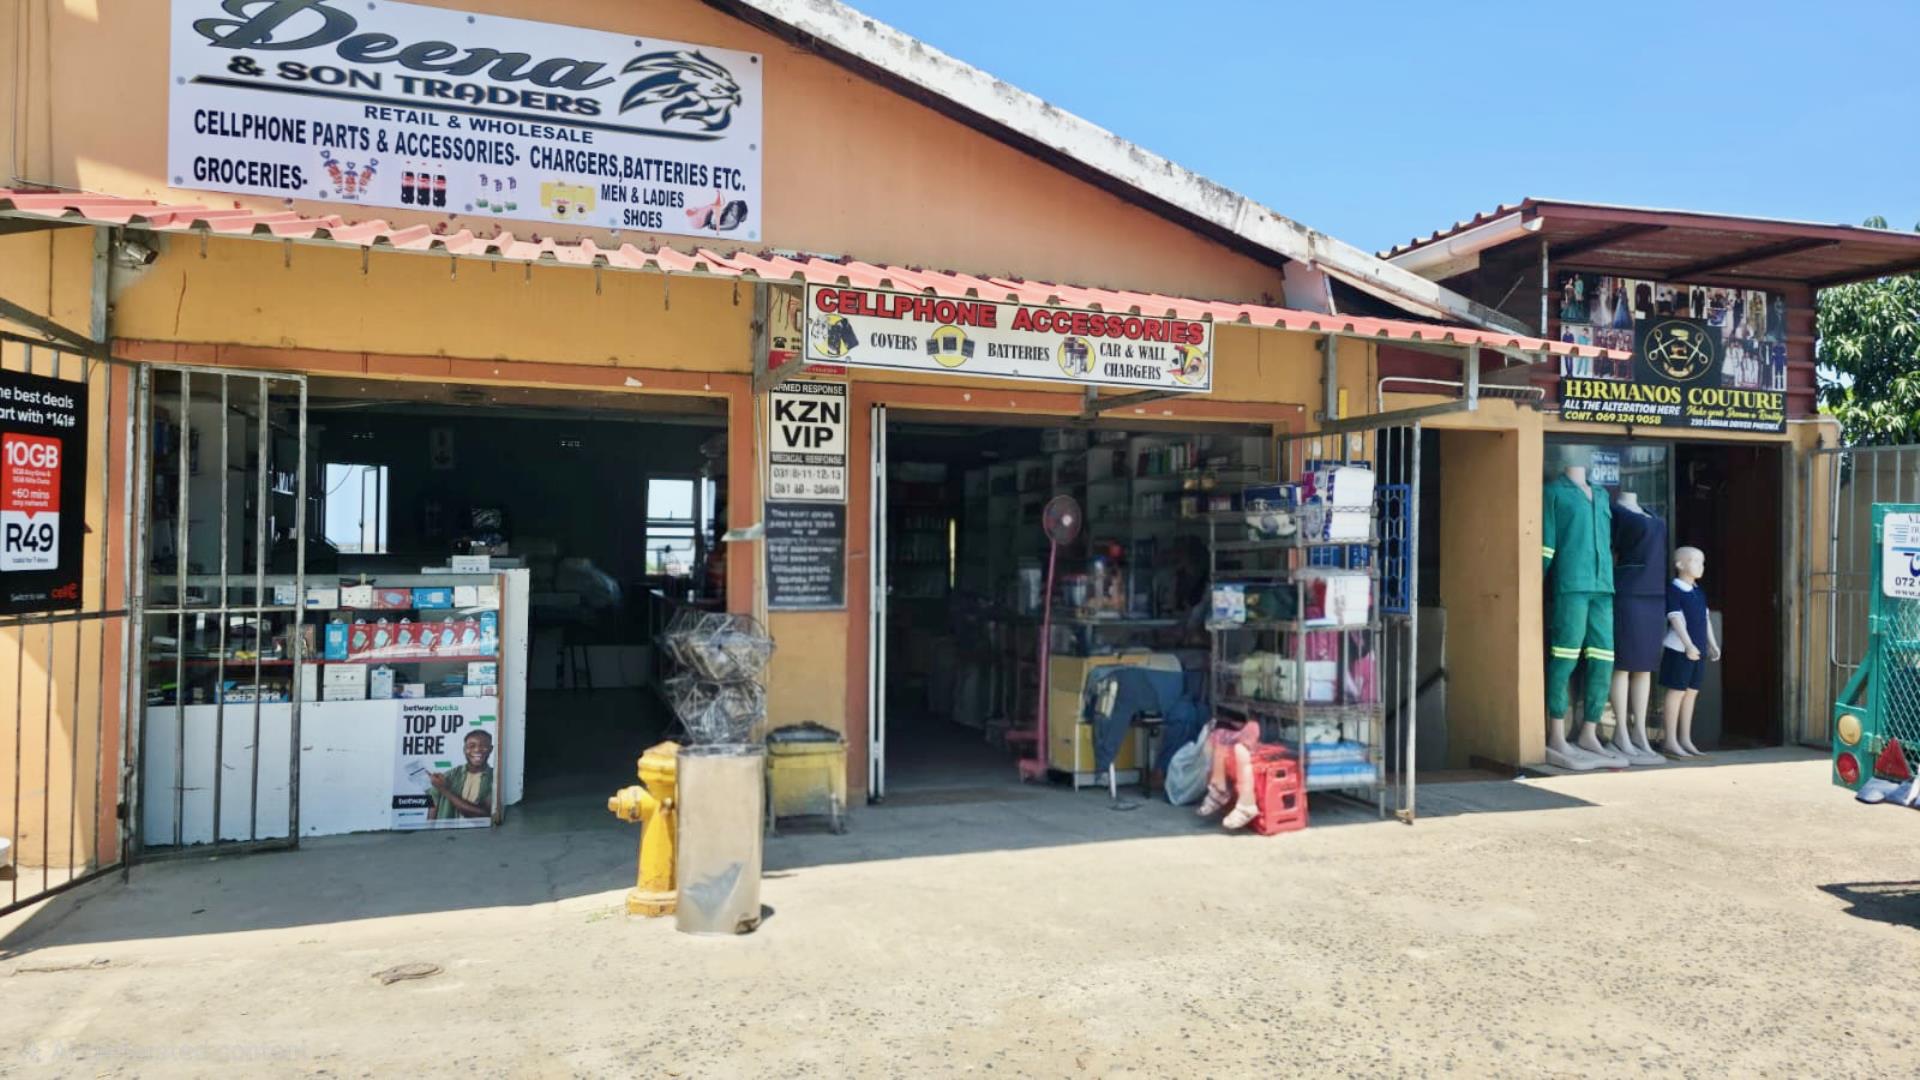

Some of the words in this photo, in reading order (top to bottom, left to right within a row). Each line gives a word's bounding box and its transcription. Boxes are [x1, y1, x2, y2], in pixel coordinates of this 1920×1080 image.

[193, 0, 616, 91] Deena
[227, 56, 264, 77] &
[277, 61, 382, 91] SON
[394, 75, 602, 116] TRADERS
[364, 105, 439, 127] RETAIL
[447, 115, 461, 128] &
[469, 117, 593, 145] WHOLESALE
[194, 109, 307, 145] CELLPHONE
[313, 121, 370, 151] PARTS
[376, 129, 389, 153] &
[713, 166, 746, 192] ETC.
[601, 183, 626, 203] MEN
[631, 187, 639, 202] &
[643, 188, 684, 209] LADIES
[623, 209, 662, 228] SHOES
[815, 287, 997, 329] CELLPHONE
[1011, 307, 1204, 345] ACCESSORIES
[870, 332, 918, 351] COVERS
[987, 342, 1050, 362] BATTERIES
[1100, 342, 1121, 358] CAR
[1125, 345, 1134, 359] &
[1139, 345, 1167, 361] WALL
[1103, 362, 1161, 380] CHARGERS
[13, 386, 41, 404] best
[42, 392, 74, 409] deals
[802, 384, 844, 395] RESPONSE
[1564, 380, 1682, 404] H3RMANOS
[1687, 387, 1784, 410] COUTURE
[17, 408, 44, 425] with
[775, 399, 841, 425] KZN
[1563, 399, 1581, 410] ALL
[1582, 401, 1601, 411] THE
[1601, 402, 1657, 415] ALTERATION
[1657, 404, 1682, 416] HERE
[1565, 411, 1594, 421] CONT.
[1595, 412, 1615, 422] 069
[782, 425, 834, 449] VIP
[5, 441, 59, 469] 10GB
[6, 523, 54, 553] R49
[403, 714, 437, 734] TOP
[441, 714, 464, 734] UP
[402, 735, 445, 756] HERE
